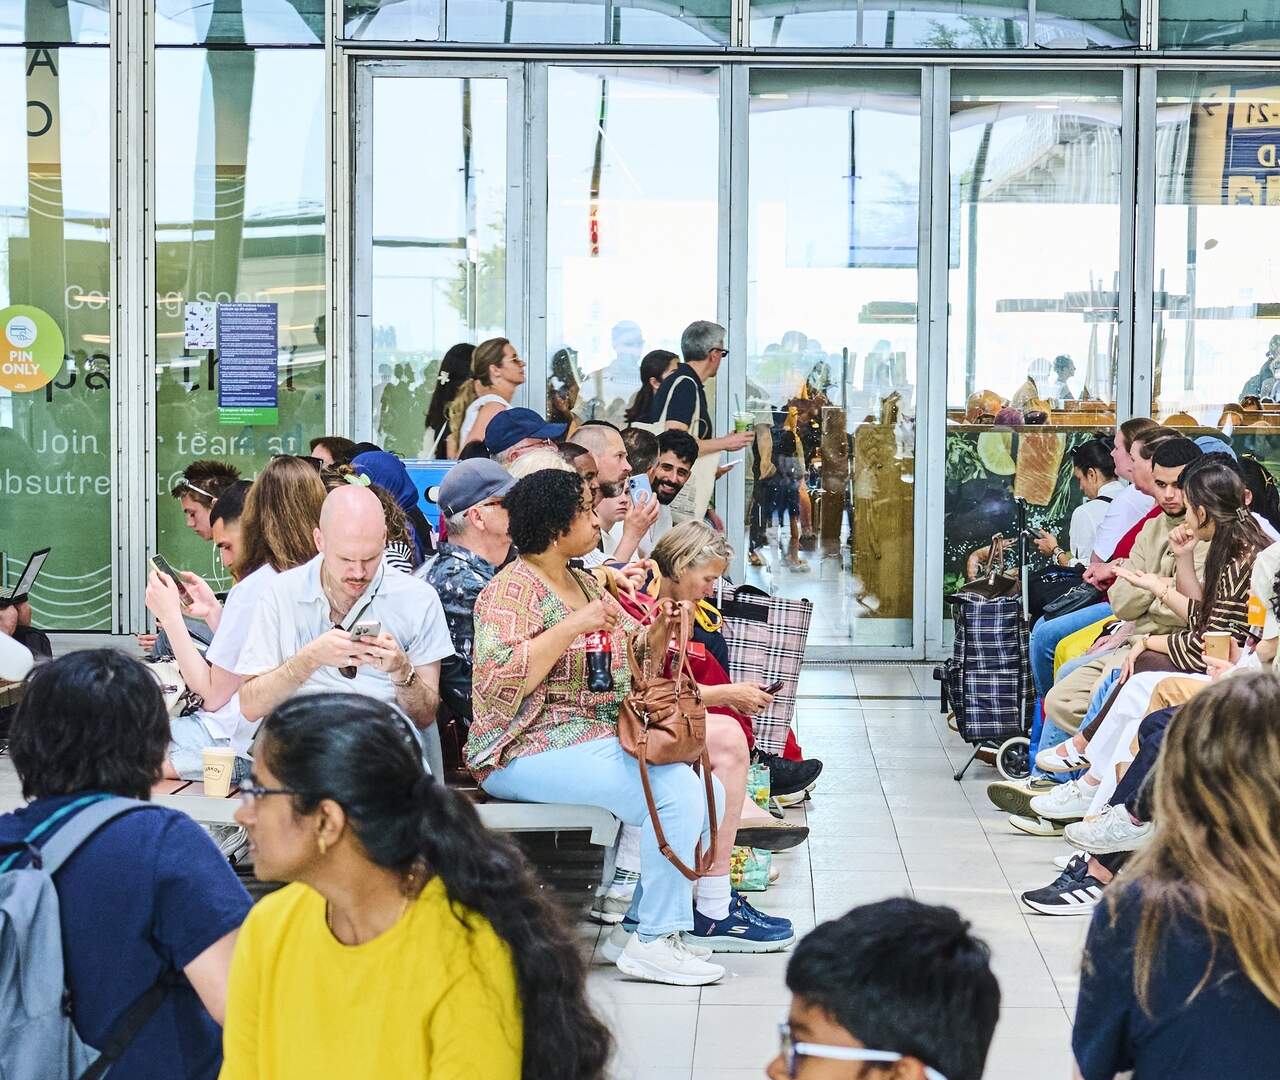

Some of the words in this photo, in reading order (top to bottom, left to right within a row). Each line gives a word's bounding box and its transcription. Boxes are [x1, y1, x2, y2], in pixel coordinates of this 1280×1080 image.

[9, 350, 34, 362] PIN
[1, 363, 41, 376] ONLY
[36, 429, 99, 454] Join
